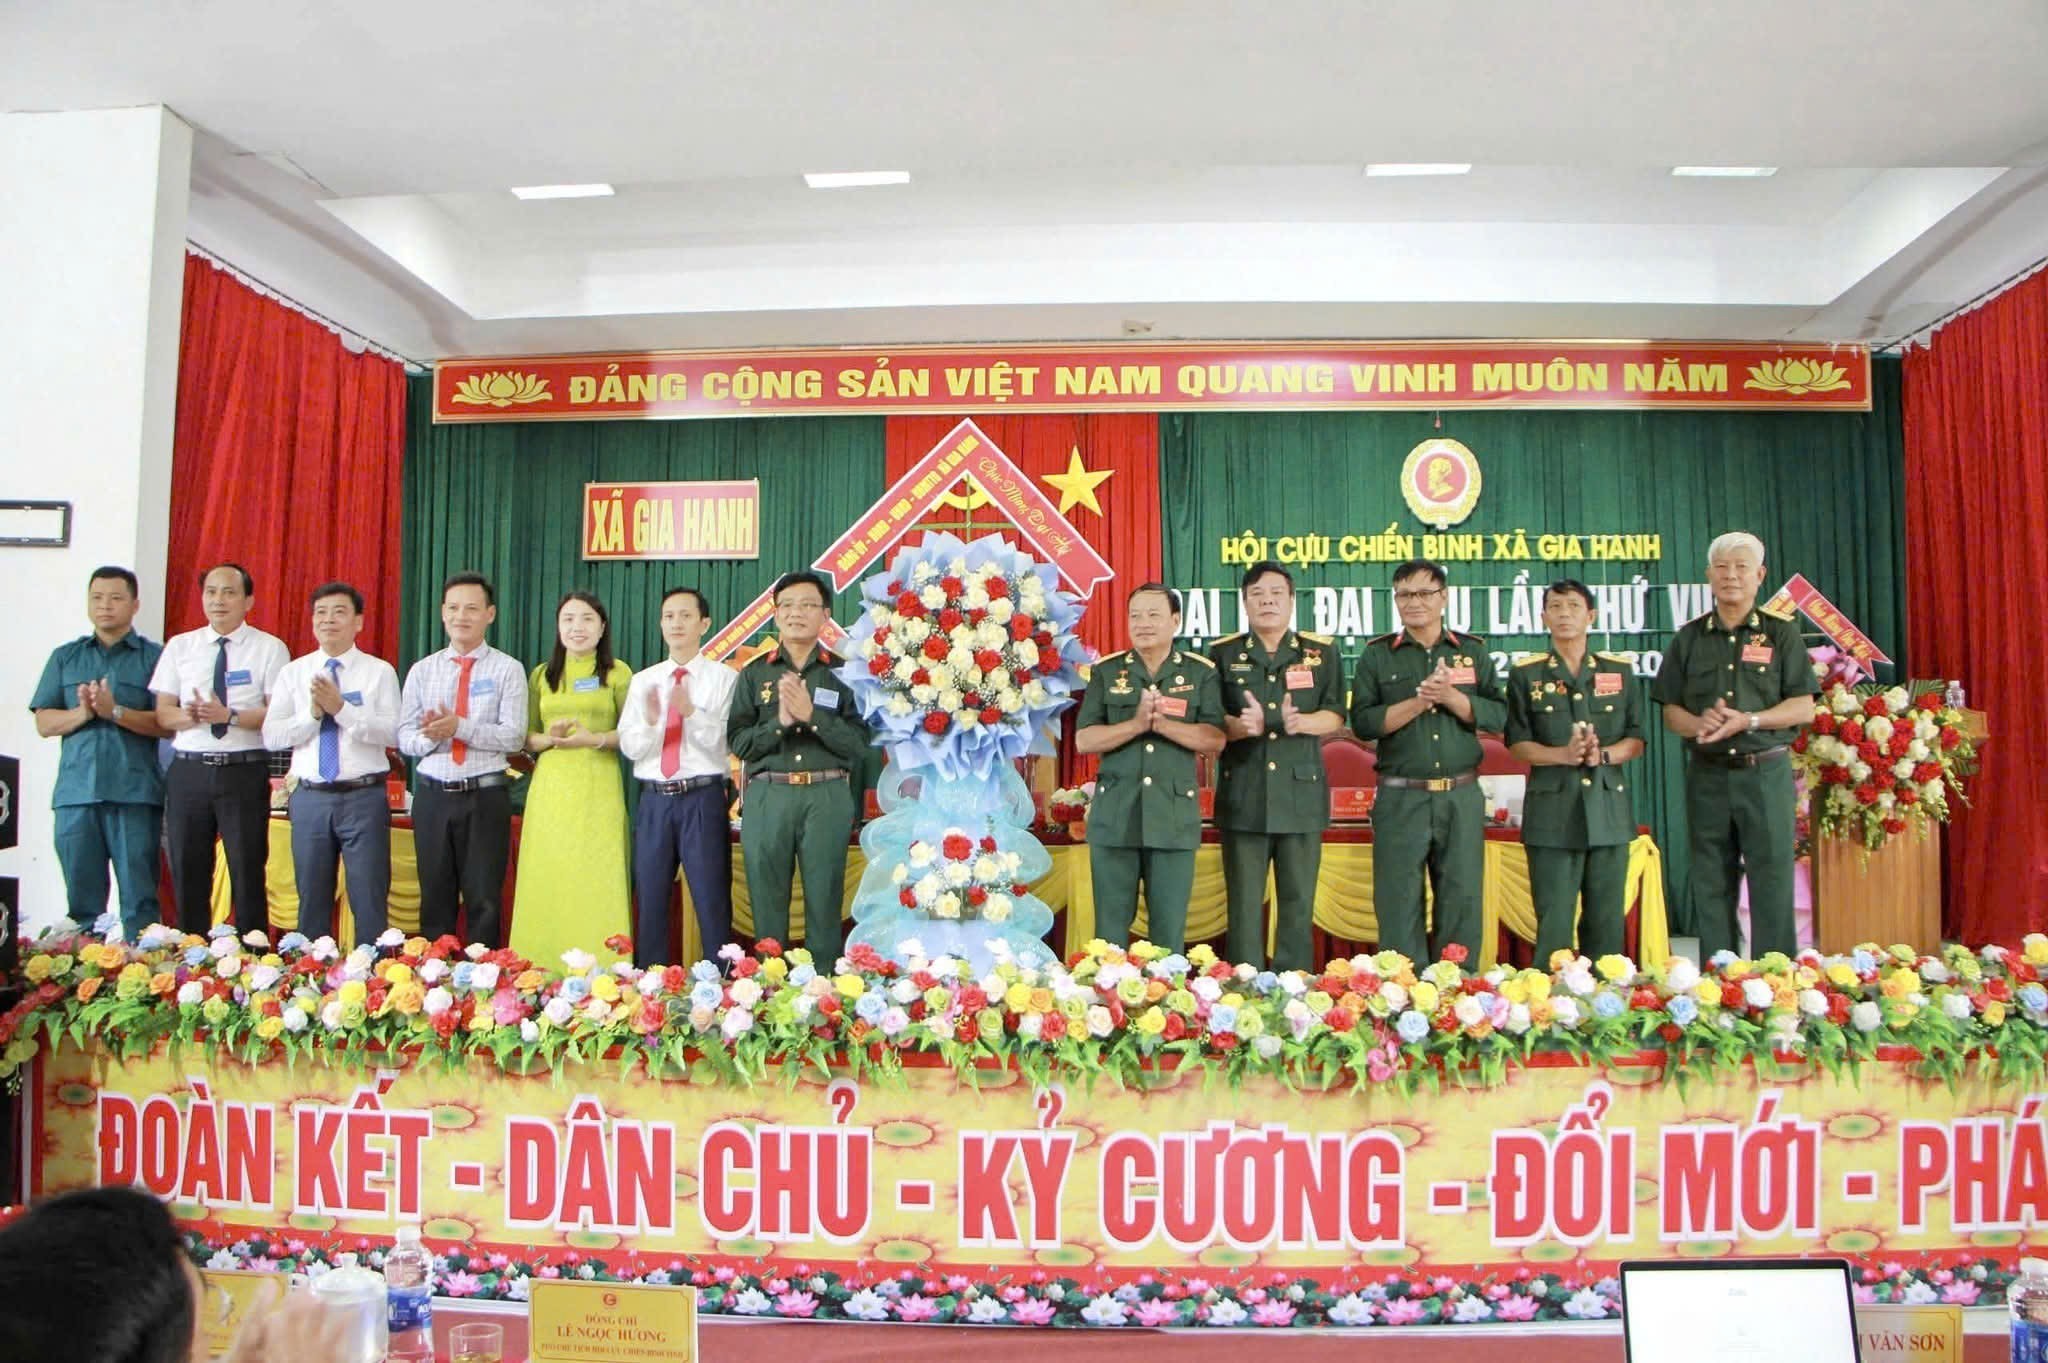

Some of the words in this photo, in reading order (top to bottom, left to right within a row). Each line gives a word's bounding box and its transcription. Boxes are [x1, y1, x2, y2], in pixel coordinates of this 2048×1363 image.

[569, 363, 688, 403] ĐẢNG
[702, 365, 822, 406] CỘNG
[837, 356, 930, 398] SẢN
[944, 360, 1040, 402] VIỆT
[1054, 365, 1161, 396] NAM
[1177, 363, 1334, 397] QUANG
[1349, 363, 1457, 393] VINH
[1472, 356, 1608, 392] MUÔN
[1623, 357, 1728, 392] NĂM
[591, 489, 625, 552] XÃ
[633, 498, 675, 552] GIA
[683, 498, 754, 551] HANH
[1221, 529, 1268, 569] HỘI
[1276, 533, 1330, 569] CỰU
[1339, 522, 1413, 562] CHIẾN
[1423, 533, 1482, 560] BINH
[1493, 529, 1531, 560] XÃ
[1538, 534, 1583, 560] GIA
[1590, 534, 1660, 560] HANH
[1314, 586, 1373, 647] ĐẠI
[97, 1079, 275, 1206] ĐOÀN
[296, 1074, 432, 1217] KẾT
[507, 1098, 674, 1231] DÂN
[701, 1083, 872, 1239] CHỦ
[960, 1088, 1075, 1245] KỶ
[1101, 1123, 1404, 1247] CƯƠNG
[1491, 1085, 1634, 1242] ĐỔI
[1661, 1093, 1819, 1236] MỚI
[1869, 1330, 1904, 1351] VĂN
[1909, 1332, 1945, 1351] SƠN
